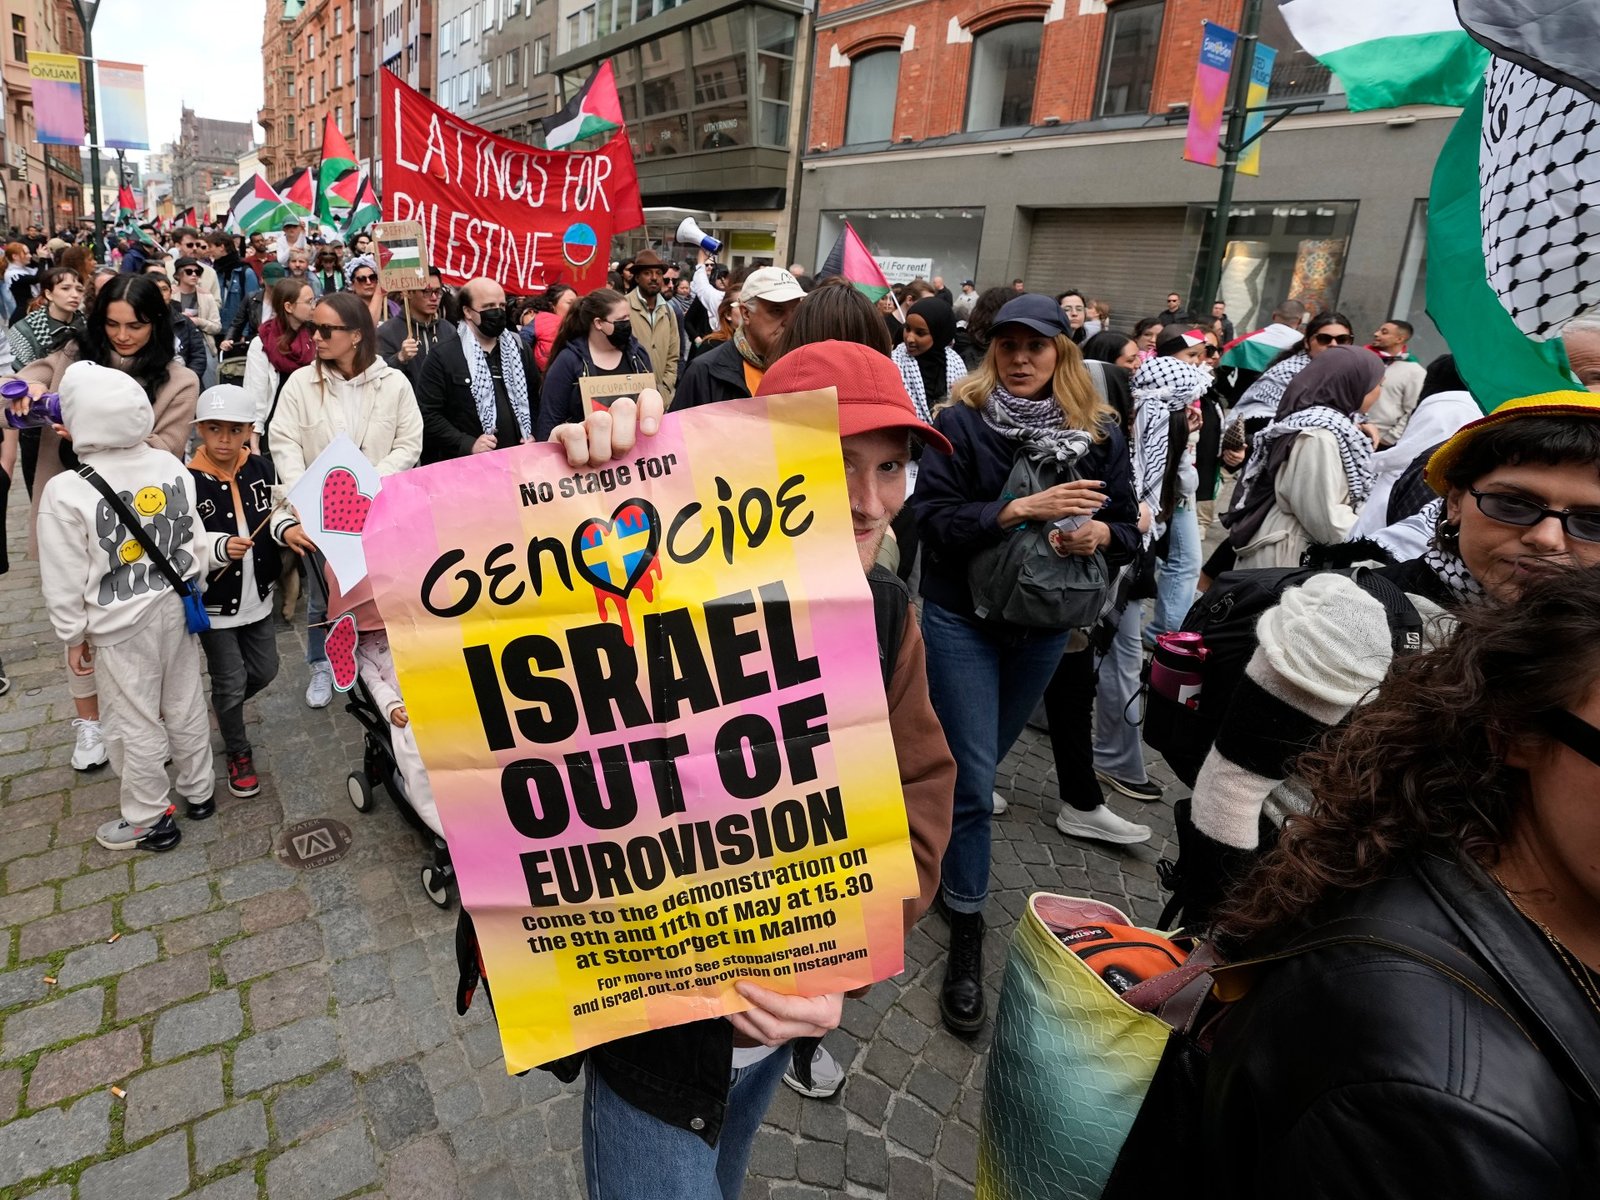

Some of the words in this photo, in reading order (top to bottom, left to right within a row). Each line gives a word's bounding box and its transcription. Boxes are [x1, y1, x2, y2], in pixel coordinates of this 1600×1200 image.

[394, 88, 550, 207] LATINOS
[562, 154, 612, 212] FOR
[394, 192, 553, 290] PALESTINE
[891, 262, 905, 271] For
[907, 263, 927, 272] rent!
[385, 277, 427, 290] PALESTINA
[211, 391, 225, 409] LA
[250, 479, 272, 512] A
[519, 481, 554, 507] No
[558, 465, 632, 498] stage
[634, 453, 677, 481] for
[463, 580, 821, 751] ISRAEL
[501, 733, 689, 839] OUT
[715, 693, 830, 799] OF
[519, 786, 848, 907] EUROVISION
[522, 912, 586, 931] Come
[589, 910, 615, 924] to
[618, 904, 658, 923] the
[662, 855, 835, 913] demonstration
[839, 848, 867, 869] on
[527, 935, 567, 953] the
[570, 930, 610, 947] 9th
[614, 926, 657, 944] and
[659, 911, 701, 938] 11th
[705, 905, 728, 927] of
[733, 896, 781, 923] May
[787, 887, 813, 910] at
[814, 872, 874, 902] 15.30
[573, 999, 599, 1016] and
[602, 967, 770, 1009] israel.out.of.eurovision
[773, 965, 791, 976] on
[794, 948, 868, 974] Instagram
[576, 951, 601, 970] at
[605, 930, 730, 965] Stortorget
[733, 928, 756, 944] in
[597, 975, 622, 991] For
[624, 970, 662, 985] more
[665, 966, 692, 980] info
[695, 960, 720, 972] see
[723, 940, 837, 966] stoppaisrael.nu
